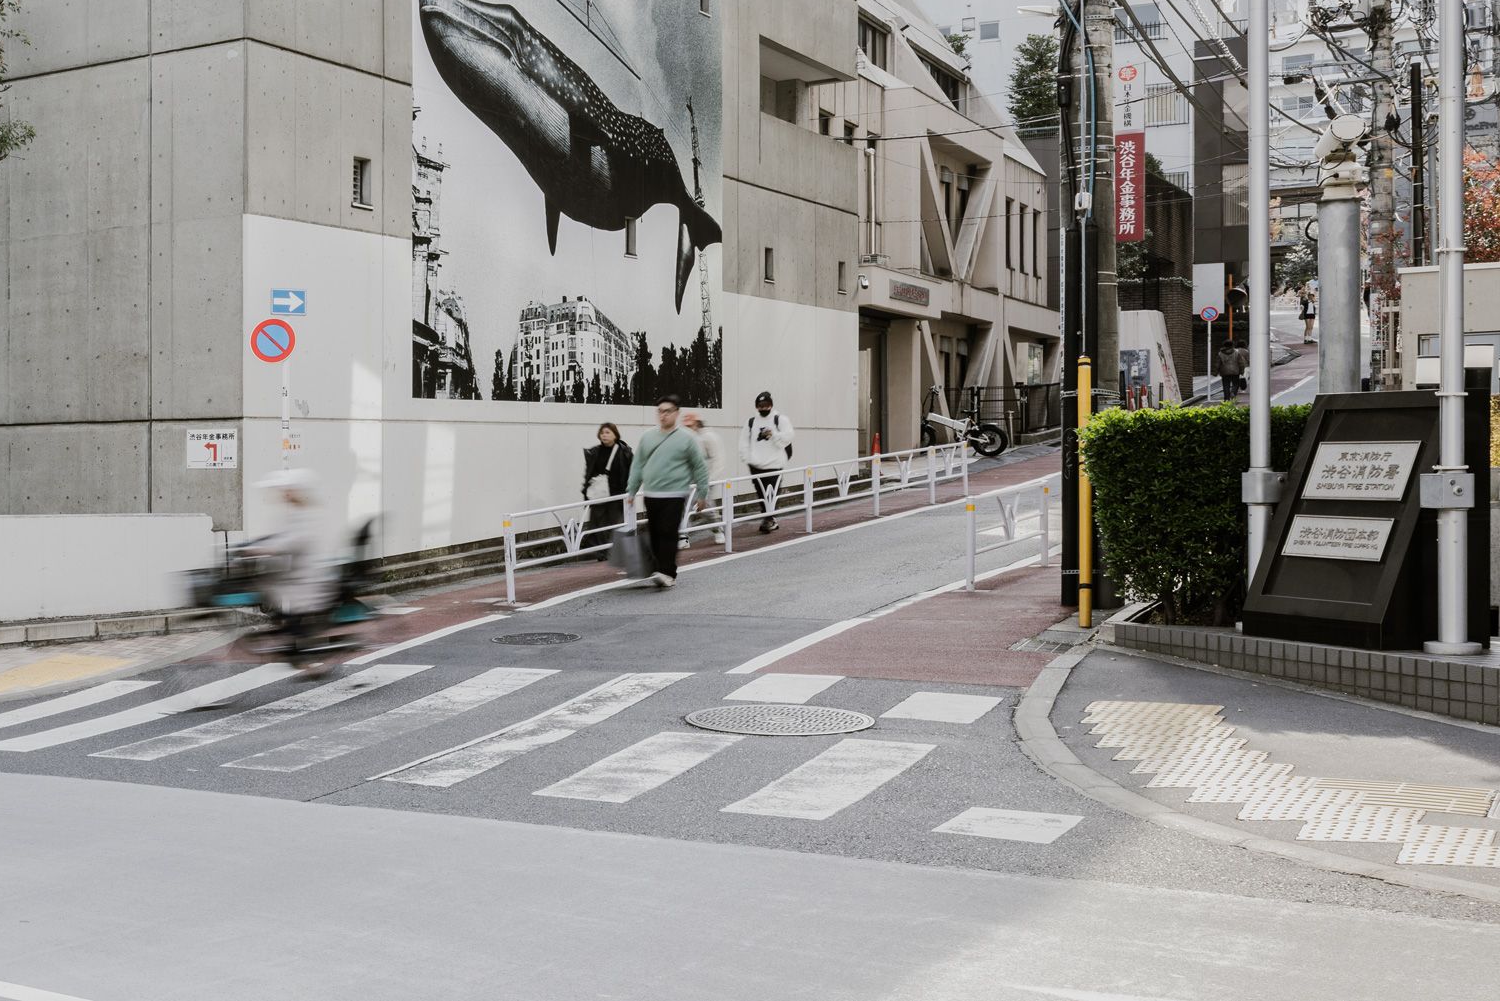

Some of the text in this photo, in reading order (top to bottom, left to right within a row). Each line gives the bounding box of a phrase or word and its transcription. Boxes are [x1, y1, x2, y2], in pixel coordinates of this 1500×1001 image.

[1119, 140, 1136, 235] 渋谷年金事務所
[189, 433, 235, 441] 渋谷年金事務所
[1338, 451, 1393, 462] 東京消防庁
[1321, 463, 1400, 479] 渋谷消防署
[1364, 483, 1395, 491] STATION
[1300, 526, 1380, 541] 渋谷消防団本部
